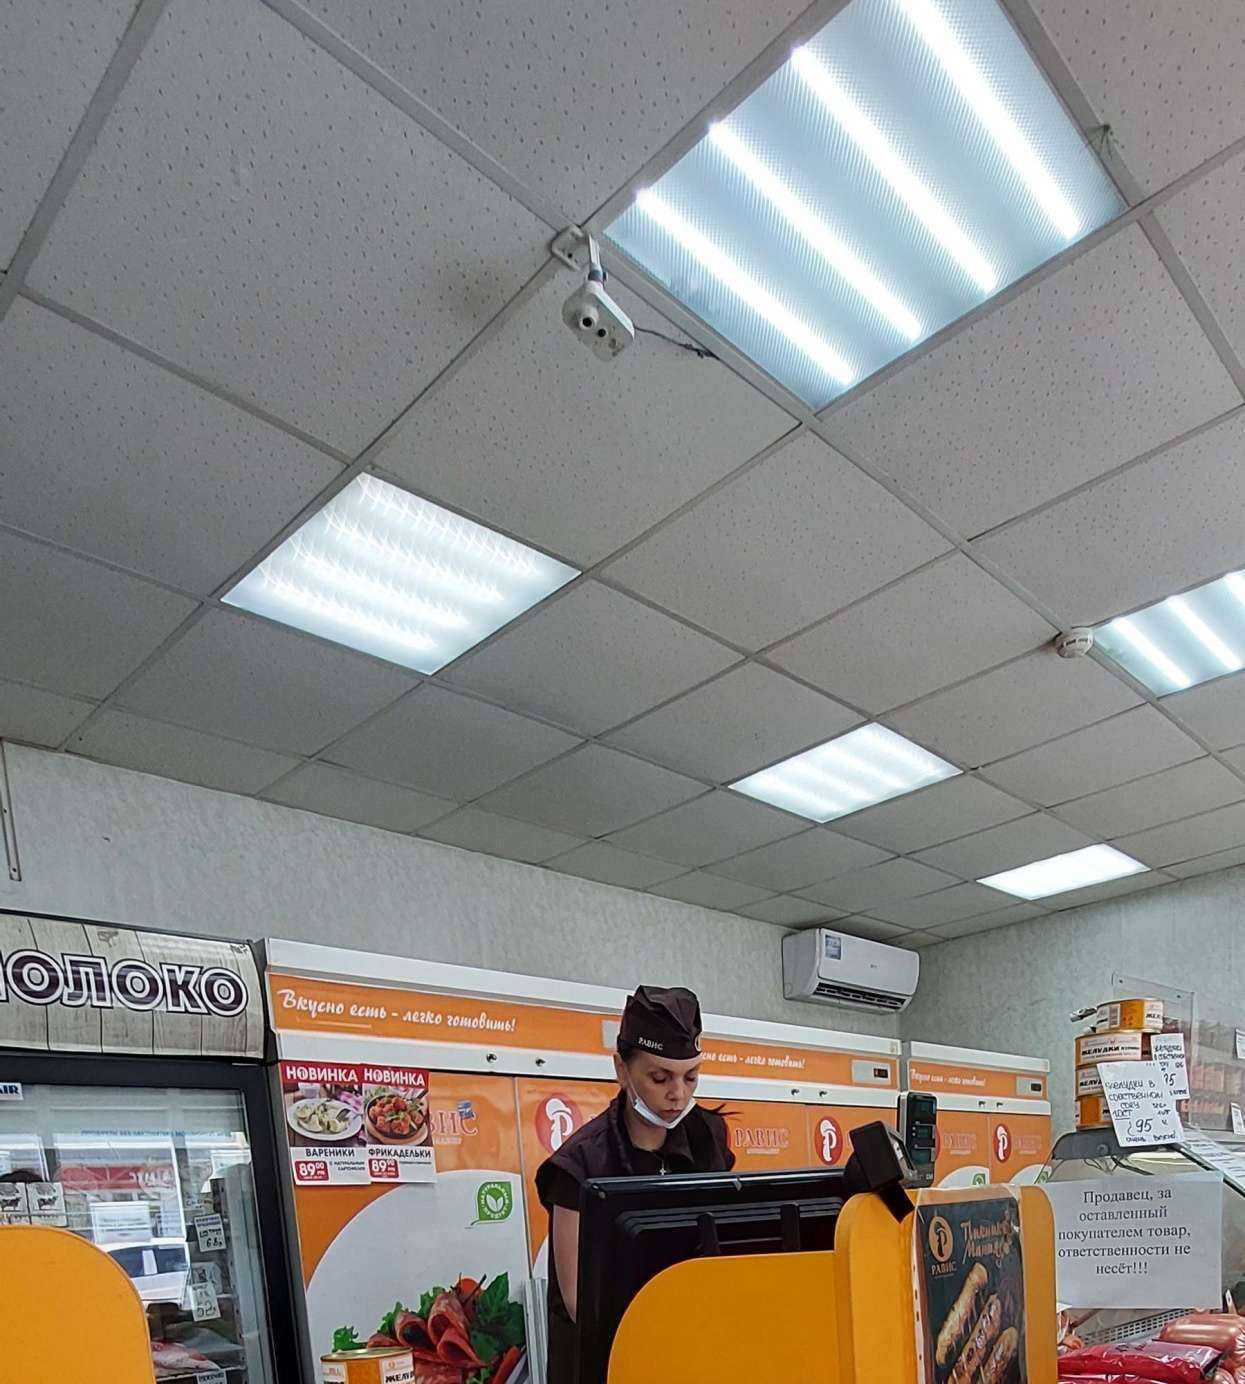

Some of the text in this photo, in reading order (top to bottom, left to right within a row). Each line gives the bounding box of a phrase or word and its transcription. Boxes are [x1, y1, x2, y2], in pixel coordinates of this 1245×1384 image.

[0, 948, 249, 1018] ОЛОКО
[277, 988, 344, 1019] Вкусно
[350, 1002, 387, 1020] есть
[402, 1010, 442, 1026] легко
[446, 1012, 516, 1032] готовить!
[638, 1036, 664, 1050] РАВИС
[286, 1066, 359, 1083] НОВИНКА
[364, 1069, 426, 1087] НОВИНКА
[735, 1128, 790, 1148] РАВИС
[305, 1149, 355, 1158] ВАРЕНИКИ
[368, 1149, 431, 1159] ФРИКАДЕЛЬКИ
[299, 1163, 316, 1176] 89
[371, 1160, 387, 1172] 89
[1083, 1189, 1172, 1205] Продавец, за
[1079, 1206, 1168, 1222] оставленный
[1058, 1225, 1191, 1243] покупателем товар,
[1058, 1246, 1191, 1258] ответственности не
[1096, 1262, 1148, 1275] несёт!!!
